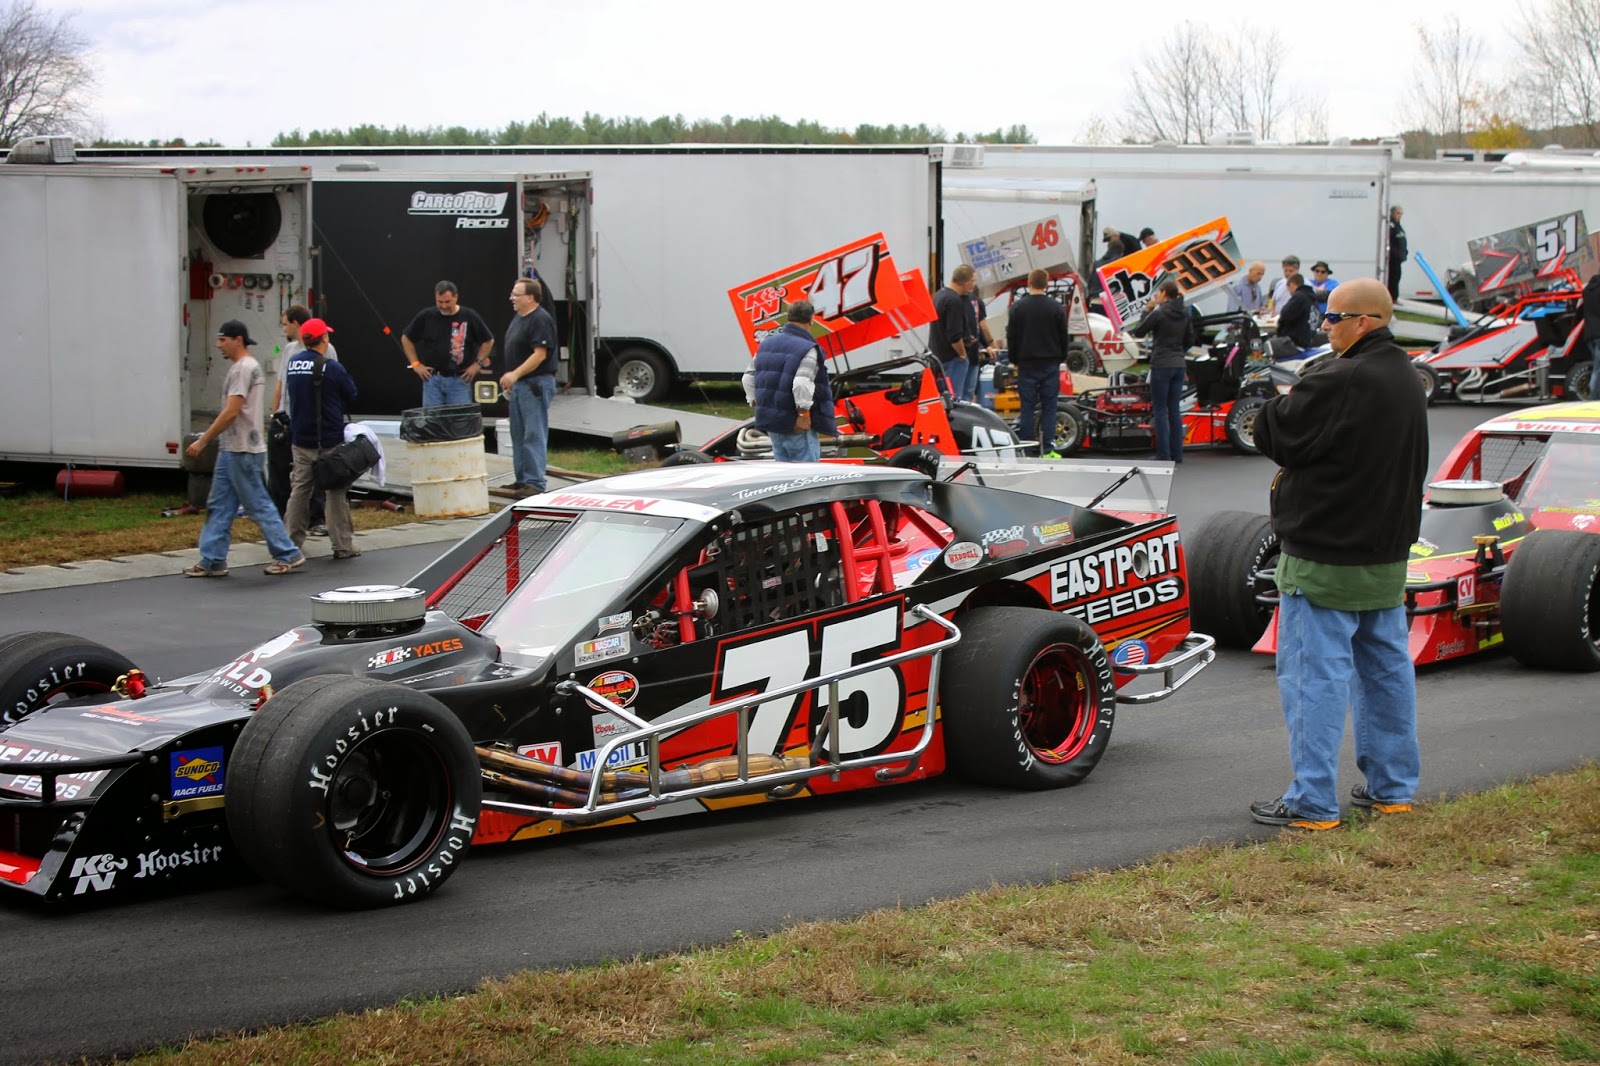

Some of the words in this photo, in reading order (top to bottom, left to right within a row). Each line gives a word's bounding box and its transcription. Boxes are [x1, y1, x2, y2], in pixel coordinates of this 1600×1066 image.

[456, 217, 509, 229] RACING
[1031, 219, 1059, 250] 46
[966, 241, 987, 256] TC
[1535, 214, 1577, 262] 51
[1161, 240, 1237, 292] 39
[807, 244, 876, 320] 47
[1098, 330, 1125, 355] 46
[288, 360, 327, 372] UCON
[547, 493, 661, 512] WHELEN
[732, 481, 789, 500] Timmy
[1459, 577, 1473, 598] CV
[412, 638, 464, 657] YATES
[595, 636, 621, 652] NASCAR
[721, 605, 901, 756] 75
[1083, 639, 1114, 729] Hoosier
[594, 723, 615, 735] Coors
[309, 706, 399, 798] Hoosier
[580, 743, 630, 771] Mbil
[637, 741, 646, 757] 1
[176, 761, 220, 777] SUNOCO
[9, 775, 81, 799] FEDS
[173, 786, 197, 797] RACE
[197, 783, 223, 794] FUELS
[133, 842, 223, 879] Hoosier
[394, 804, 476, 899] Hoosier
[69, 853, 129, 896] K&N
